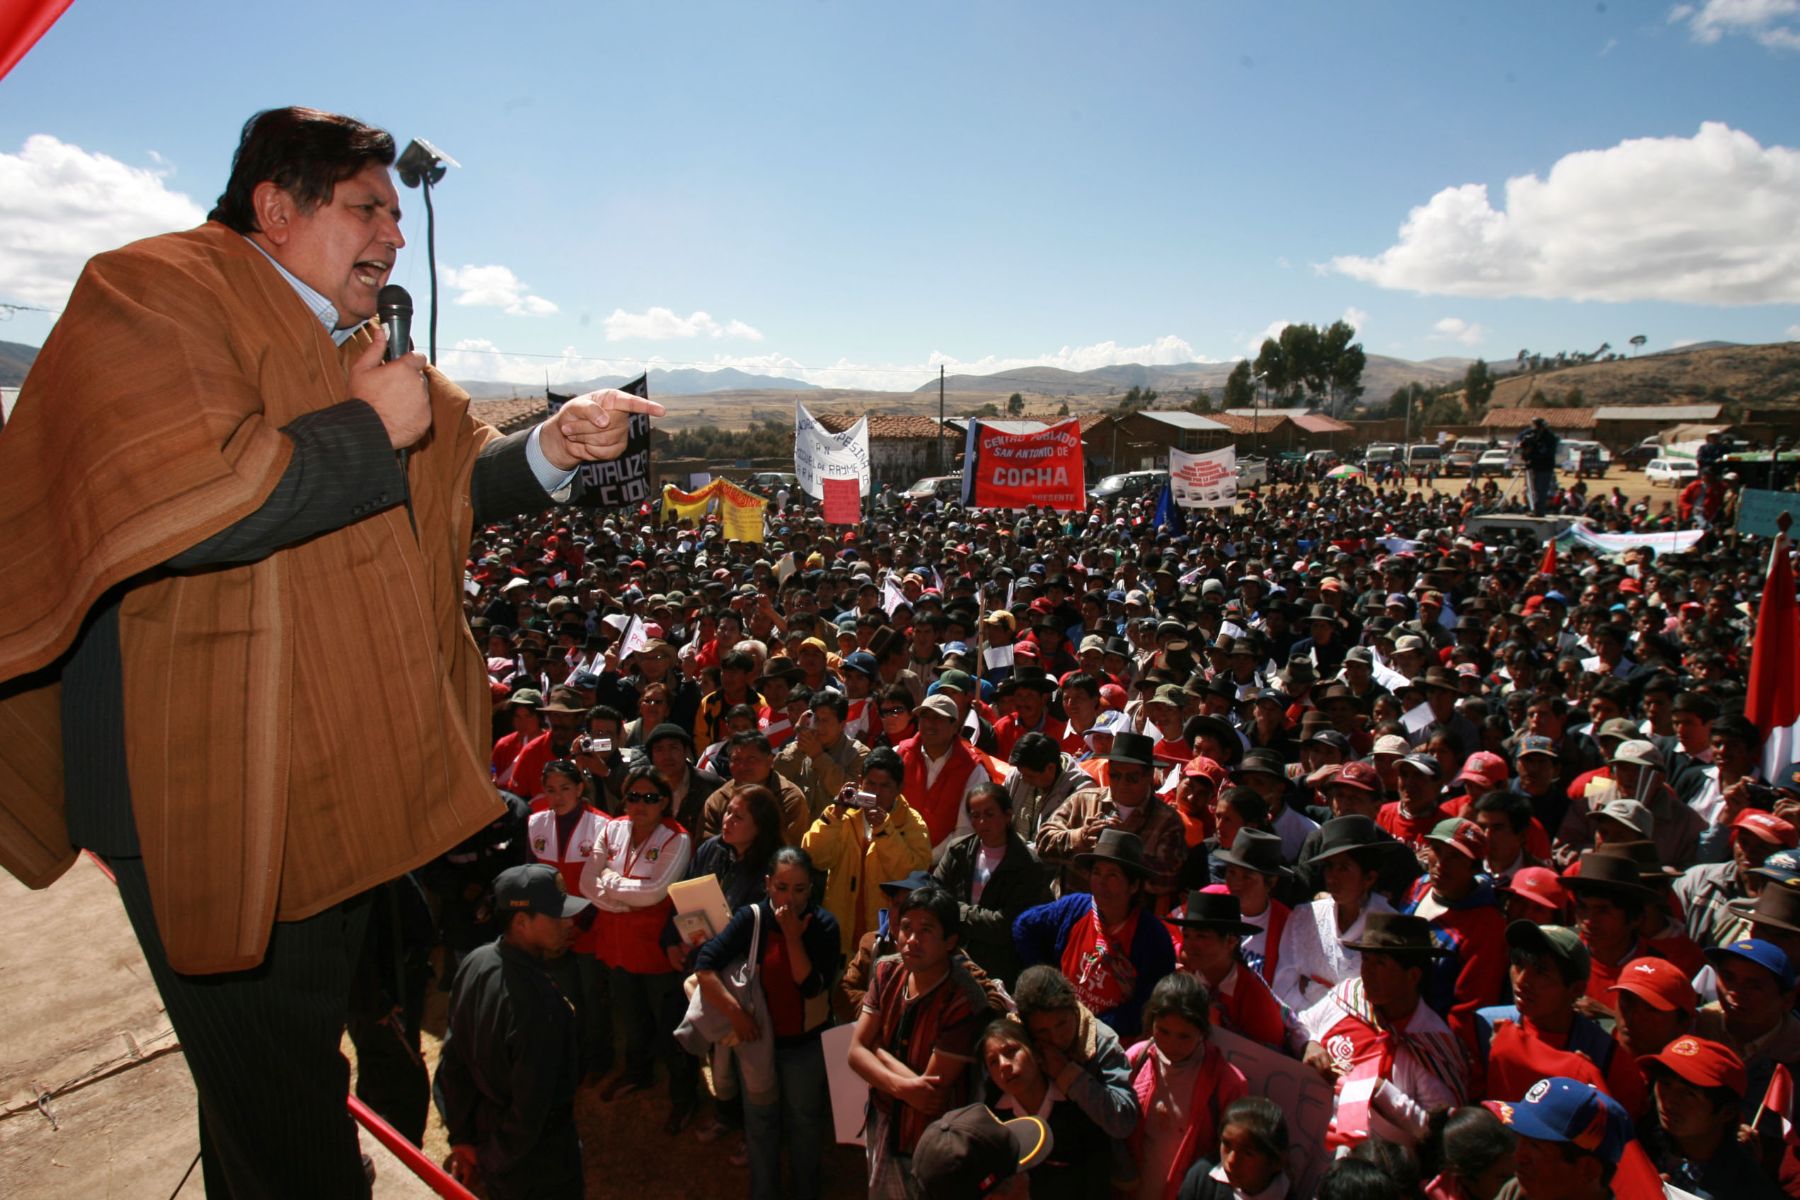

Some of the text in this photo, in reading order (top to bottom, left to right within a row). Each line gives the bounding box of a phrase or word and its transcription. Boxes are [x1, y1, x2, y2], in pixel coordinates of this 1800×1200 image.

[994, 446, 1068, 459] SAN ANTONIO DE
[992, 466, 1069, 487] COCHA
